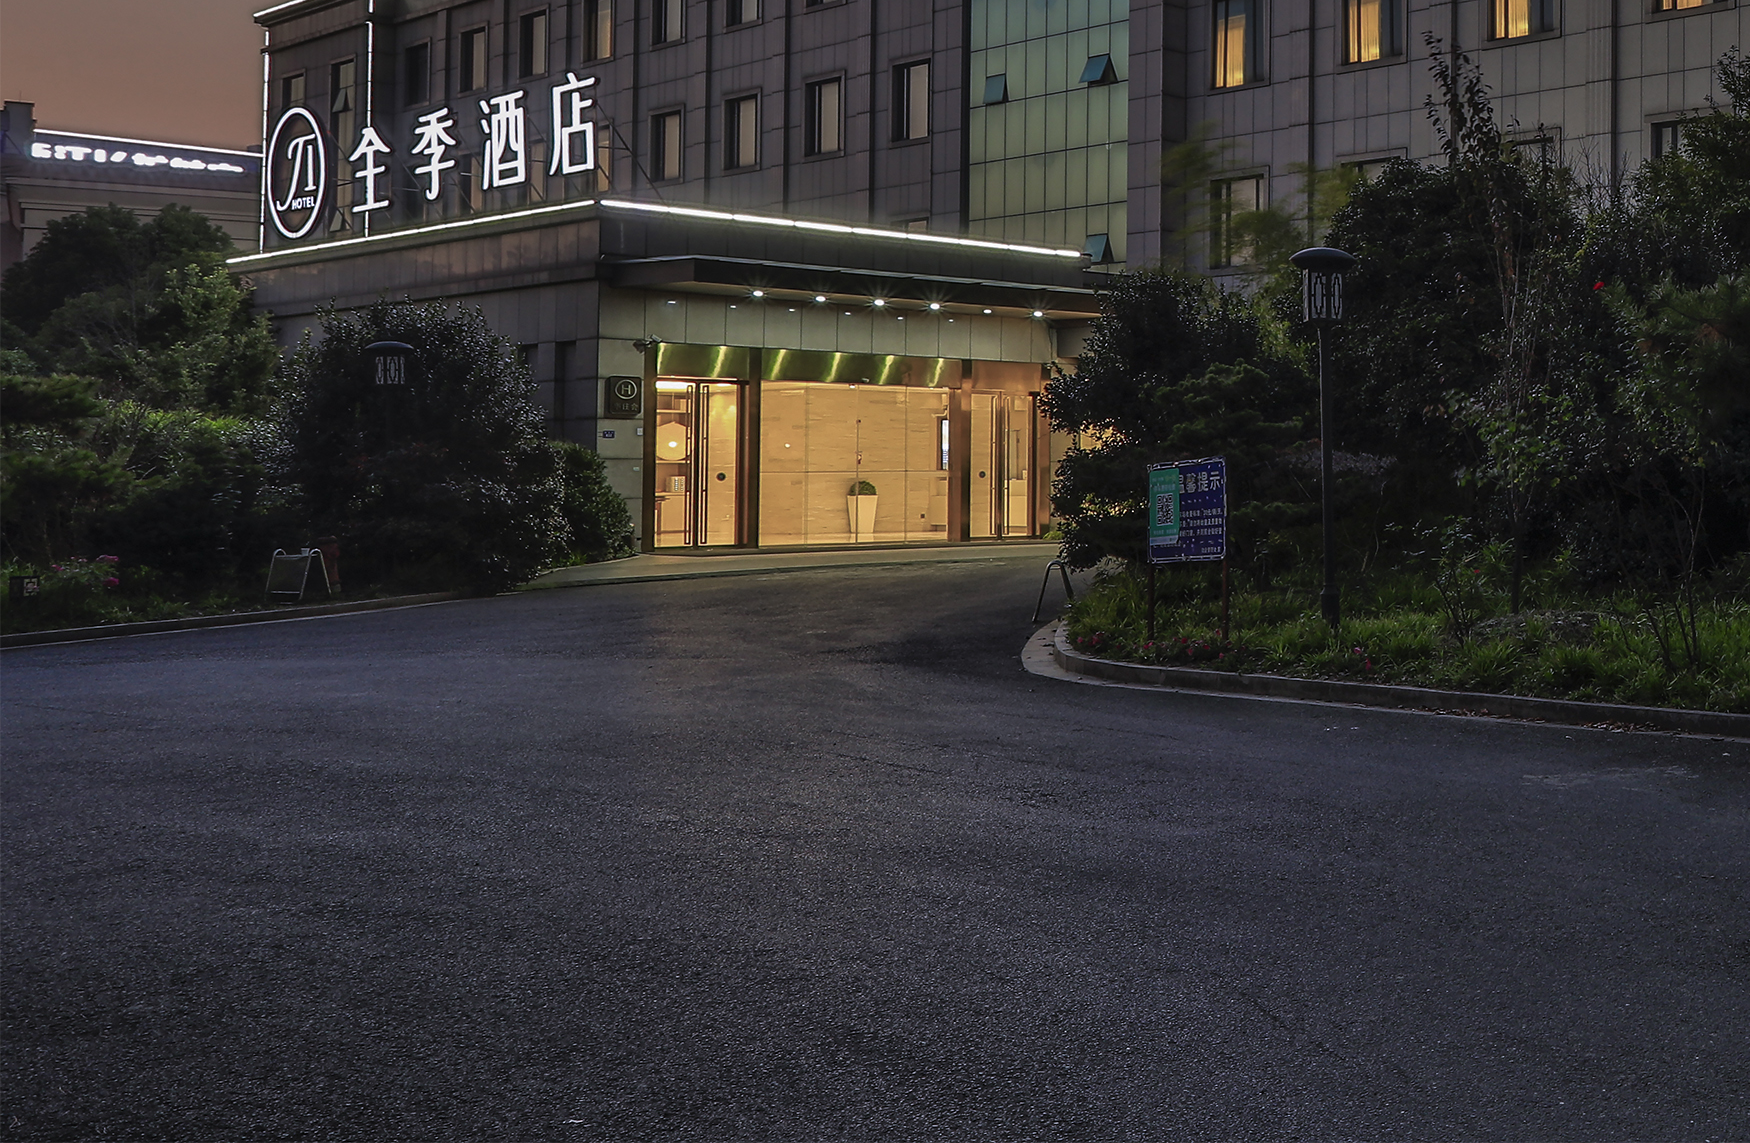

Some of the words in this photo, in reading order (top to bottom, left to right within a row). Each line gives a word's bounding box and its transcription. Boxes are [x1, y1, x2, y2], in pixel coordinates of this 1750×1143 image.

[349, 72, 596, 213] 全季酒店
[291, 196, 315, 210] HOTEL
